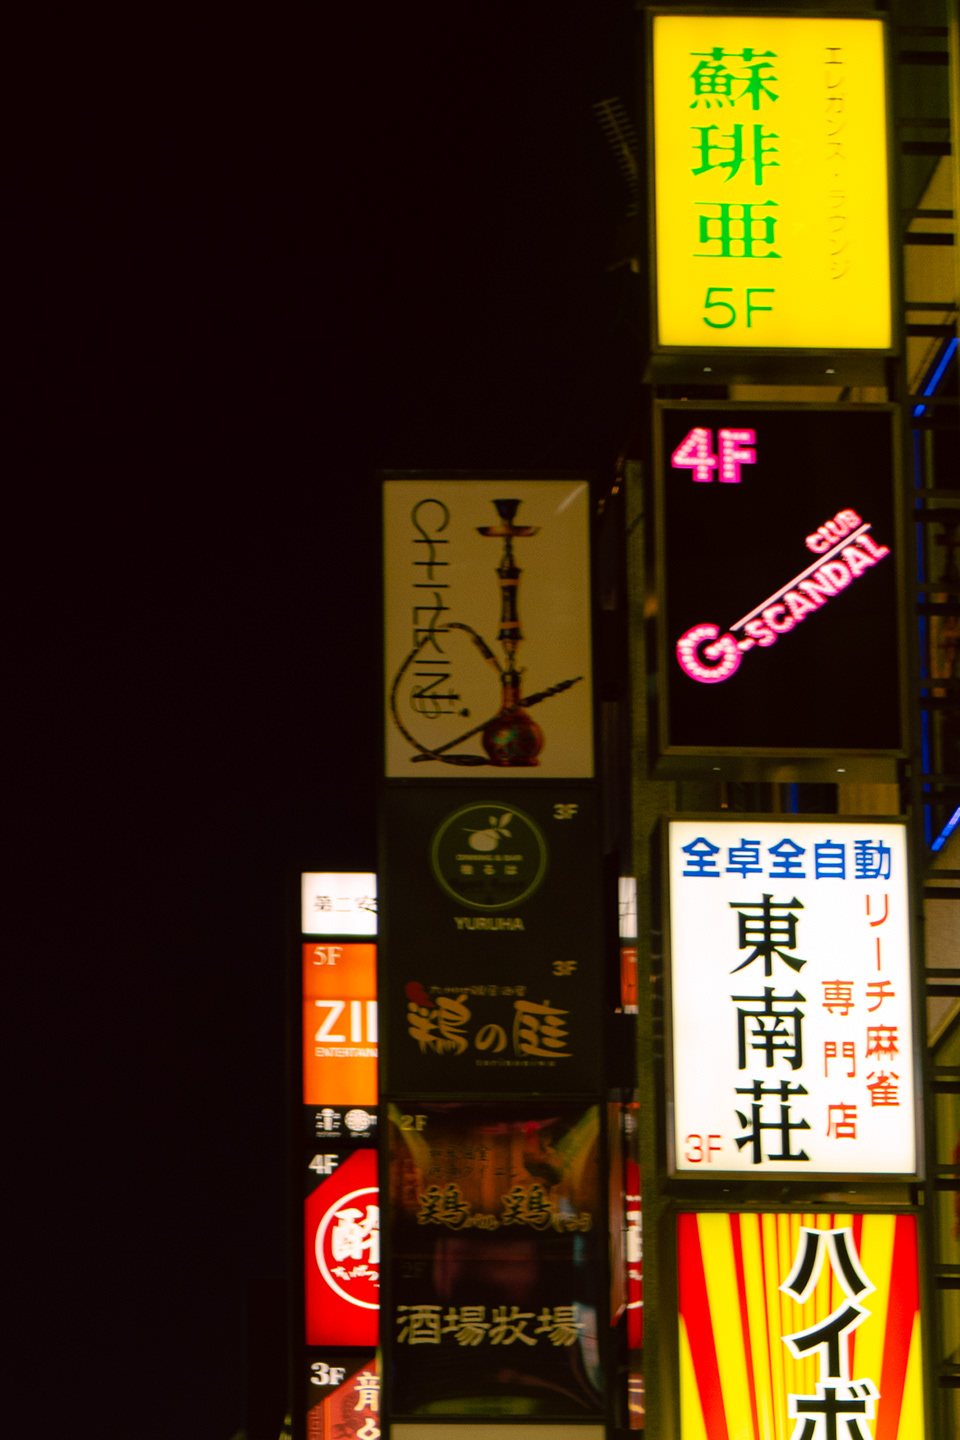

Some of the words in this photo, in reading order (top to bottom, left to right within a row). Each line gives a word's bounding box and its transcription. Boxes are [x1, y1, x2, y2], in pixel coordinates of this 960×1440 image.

[702, 288, 775, 328] 5F
[671, 427, 757, 483] 4F
[805, 508, 862, 555] CLUB
[677, 532, 891, 684] G-SCANDAL
[553, 803, 579, 820] 3F
[682, 837, 892, 880] 全卓全自動
[453, 917, 526, 931] YURUHA
[313, 946, 342, 965] 5F
[552, 960, 578, 976] 3F
[865, 893, 900, 1108] リーチ麻雀
[729, 893, 811, 1165] 東南荘
[821, 979, 858, 1140] 専門店
[399, 1115, 428, 1132] 2F
[309, 1154, 338, 1175] 4F
[685, 1134, 723, 1164] 3F
[395, 1304, 586, 1348] 酒場牧場
[310, 1362, 346, 1386] 3F
